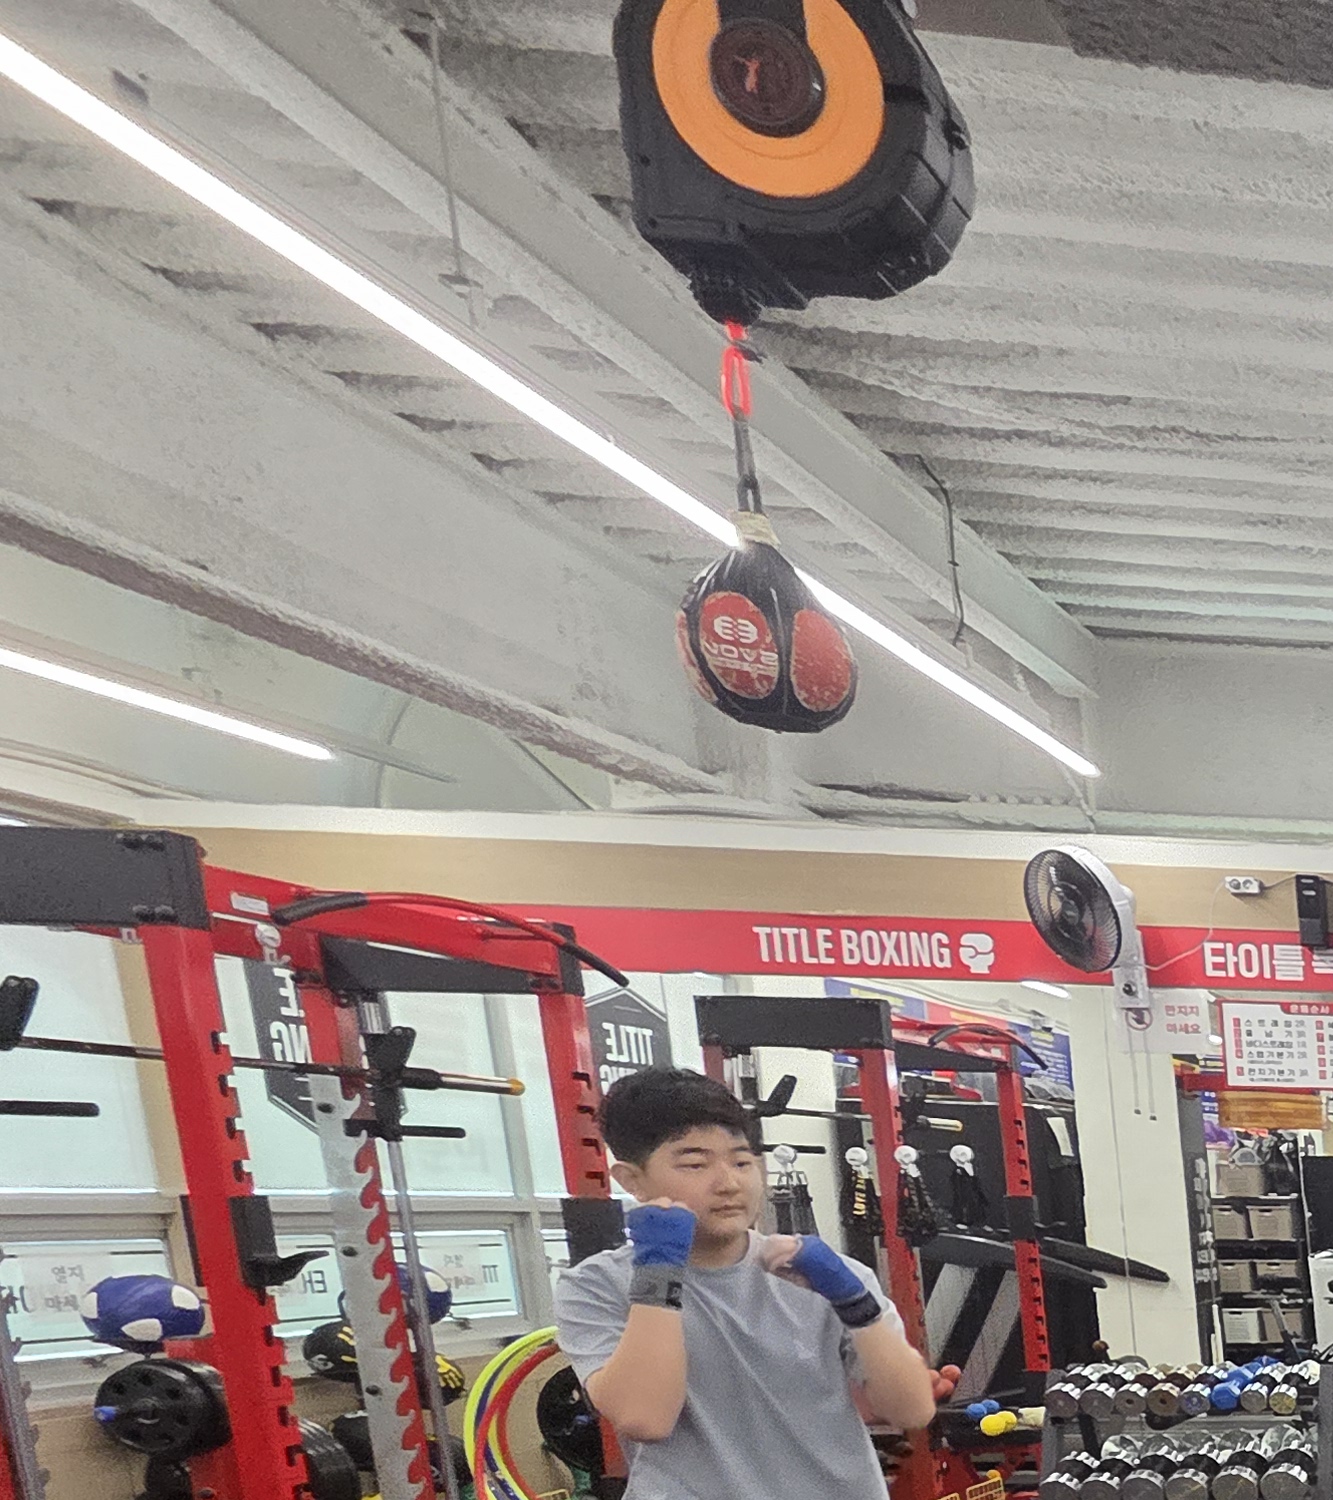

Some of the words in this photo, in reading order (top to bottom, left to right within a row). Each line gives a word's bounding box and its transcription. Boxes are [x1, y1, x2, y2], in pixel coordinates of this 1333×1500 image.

[752, 926, 836, 964] TITLE
[840, 929, 952, 968] BOXING
[1203, 942, 1306, 981] 타이틀
